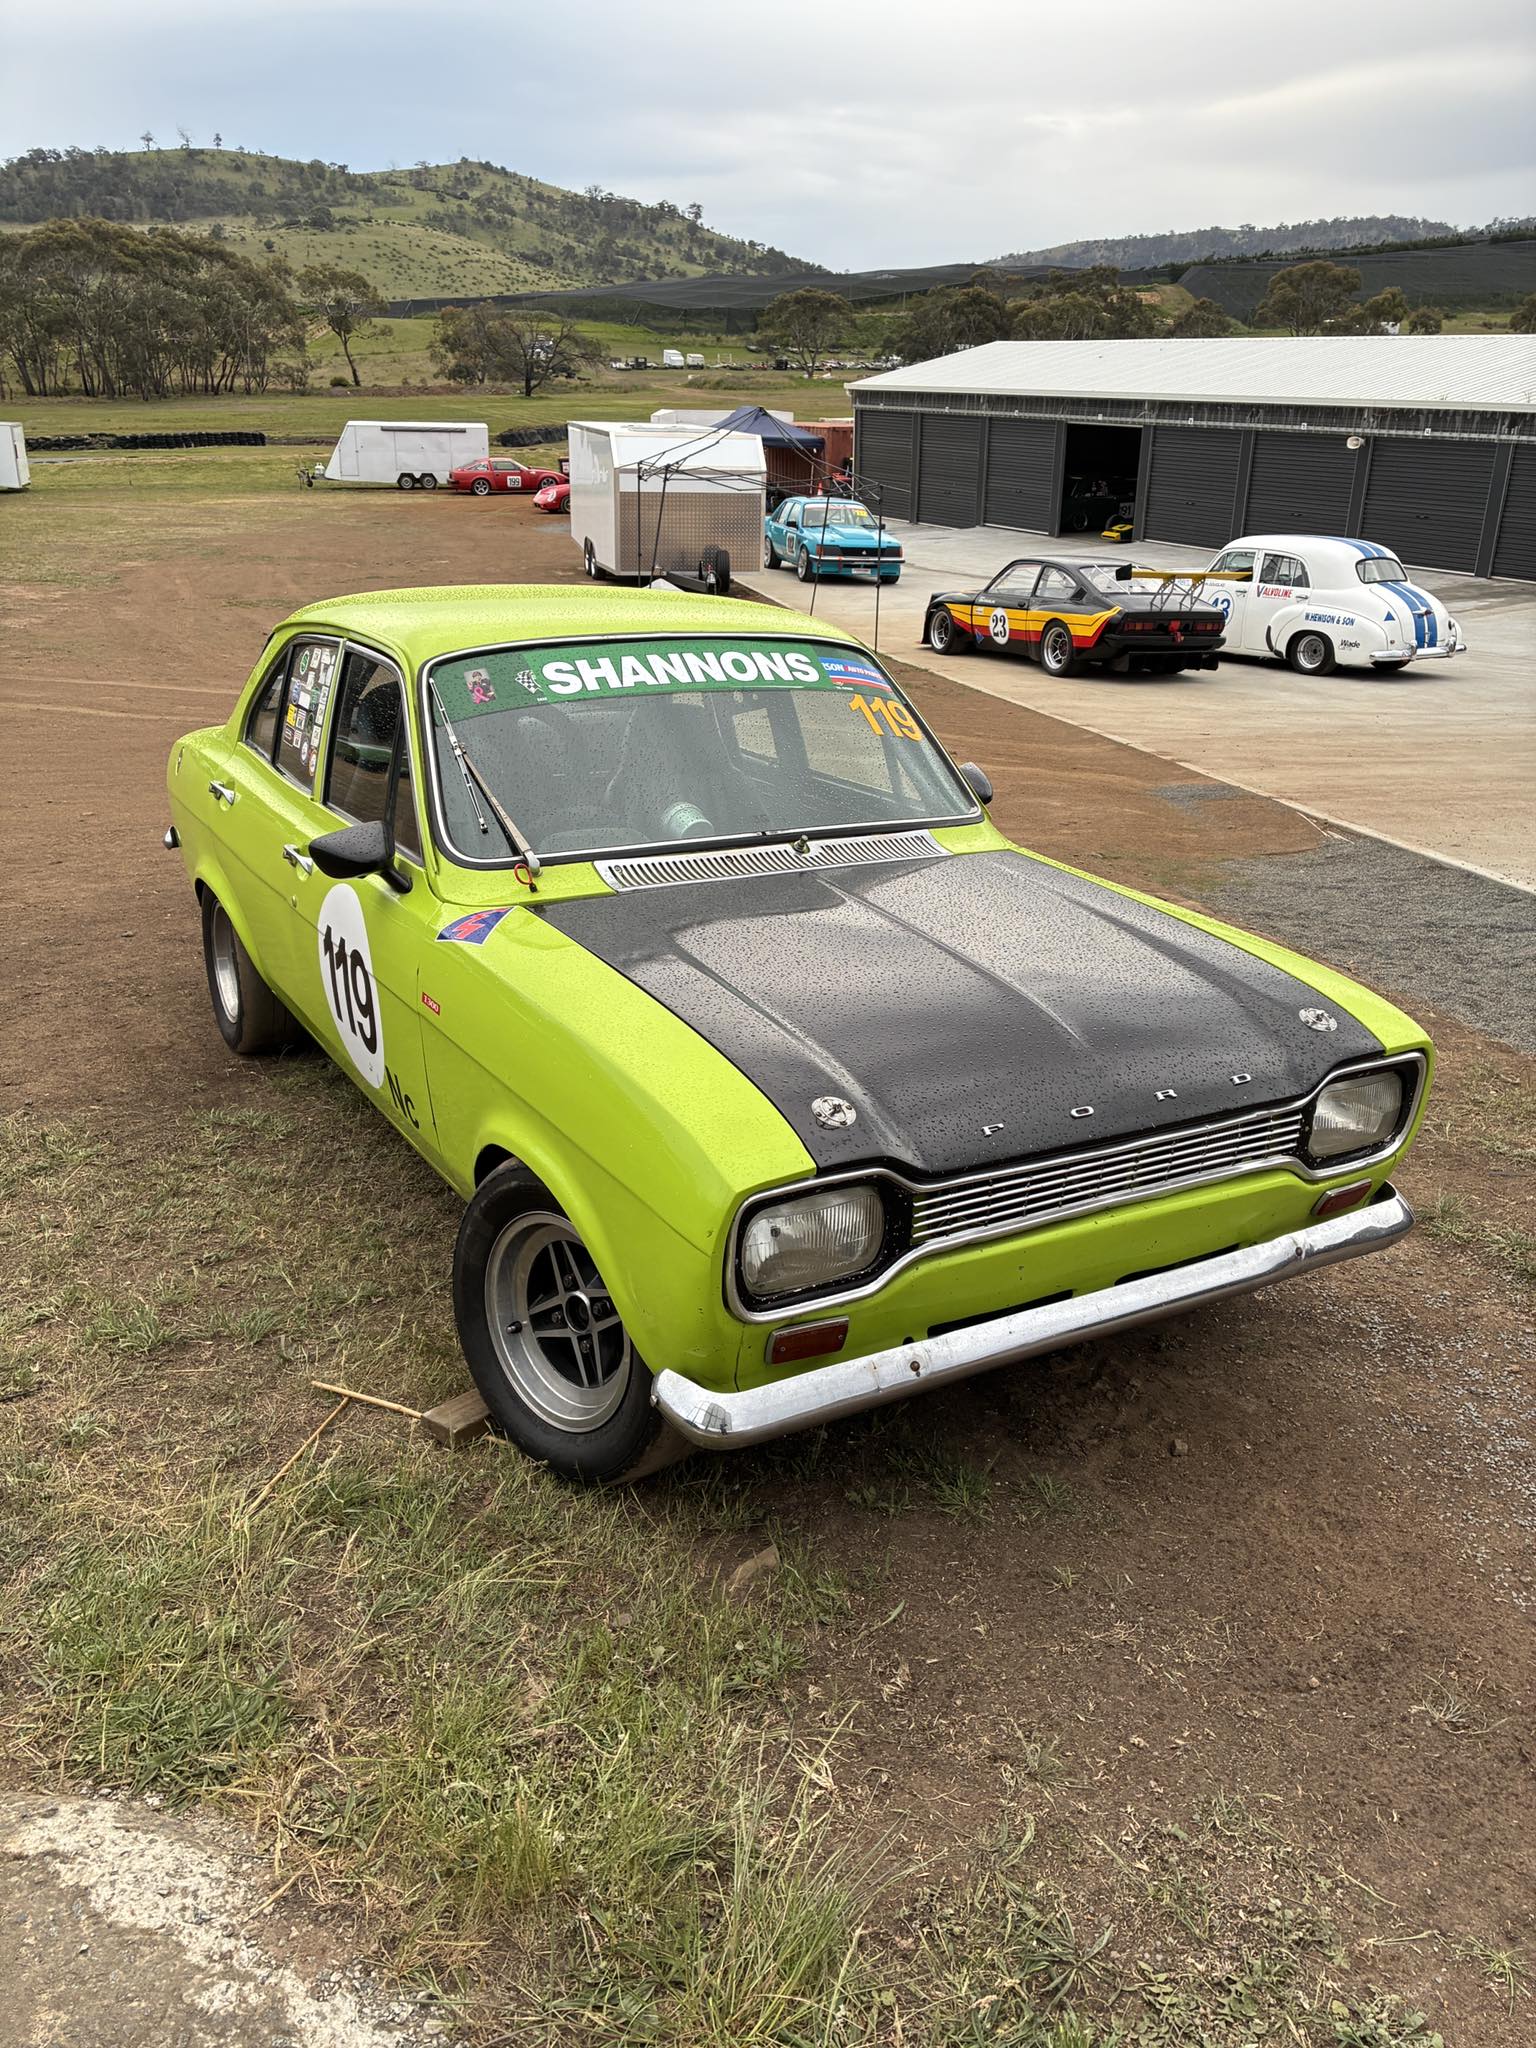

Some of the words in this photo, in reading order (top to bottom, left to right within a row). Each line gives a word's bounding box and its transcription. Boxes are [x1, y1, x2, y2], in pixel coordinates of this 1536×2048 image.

[508, 477, 520, 487] 199
[1257, 585, 1293, 598] VALVOLINE
[992, 614, 1007, 638] 23
[1336, 616, 1341, 625] &
[1341, 616, 1356, 626] SON
[1340, 639, 1361, 649] Wade
[541, 650, 820, 695] SHANNONS
[848, 693, 923, 742] 119
[323, 923, 377, 1055] 119
[423, 995, 439, 1012] 1300
[981, 1072, 1253, 1137] FORD
